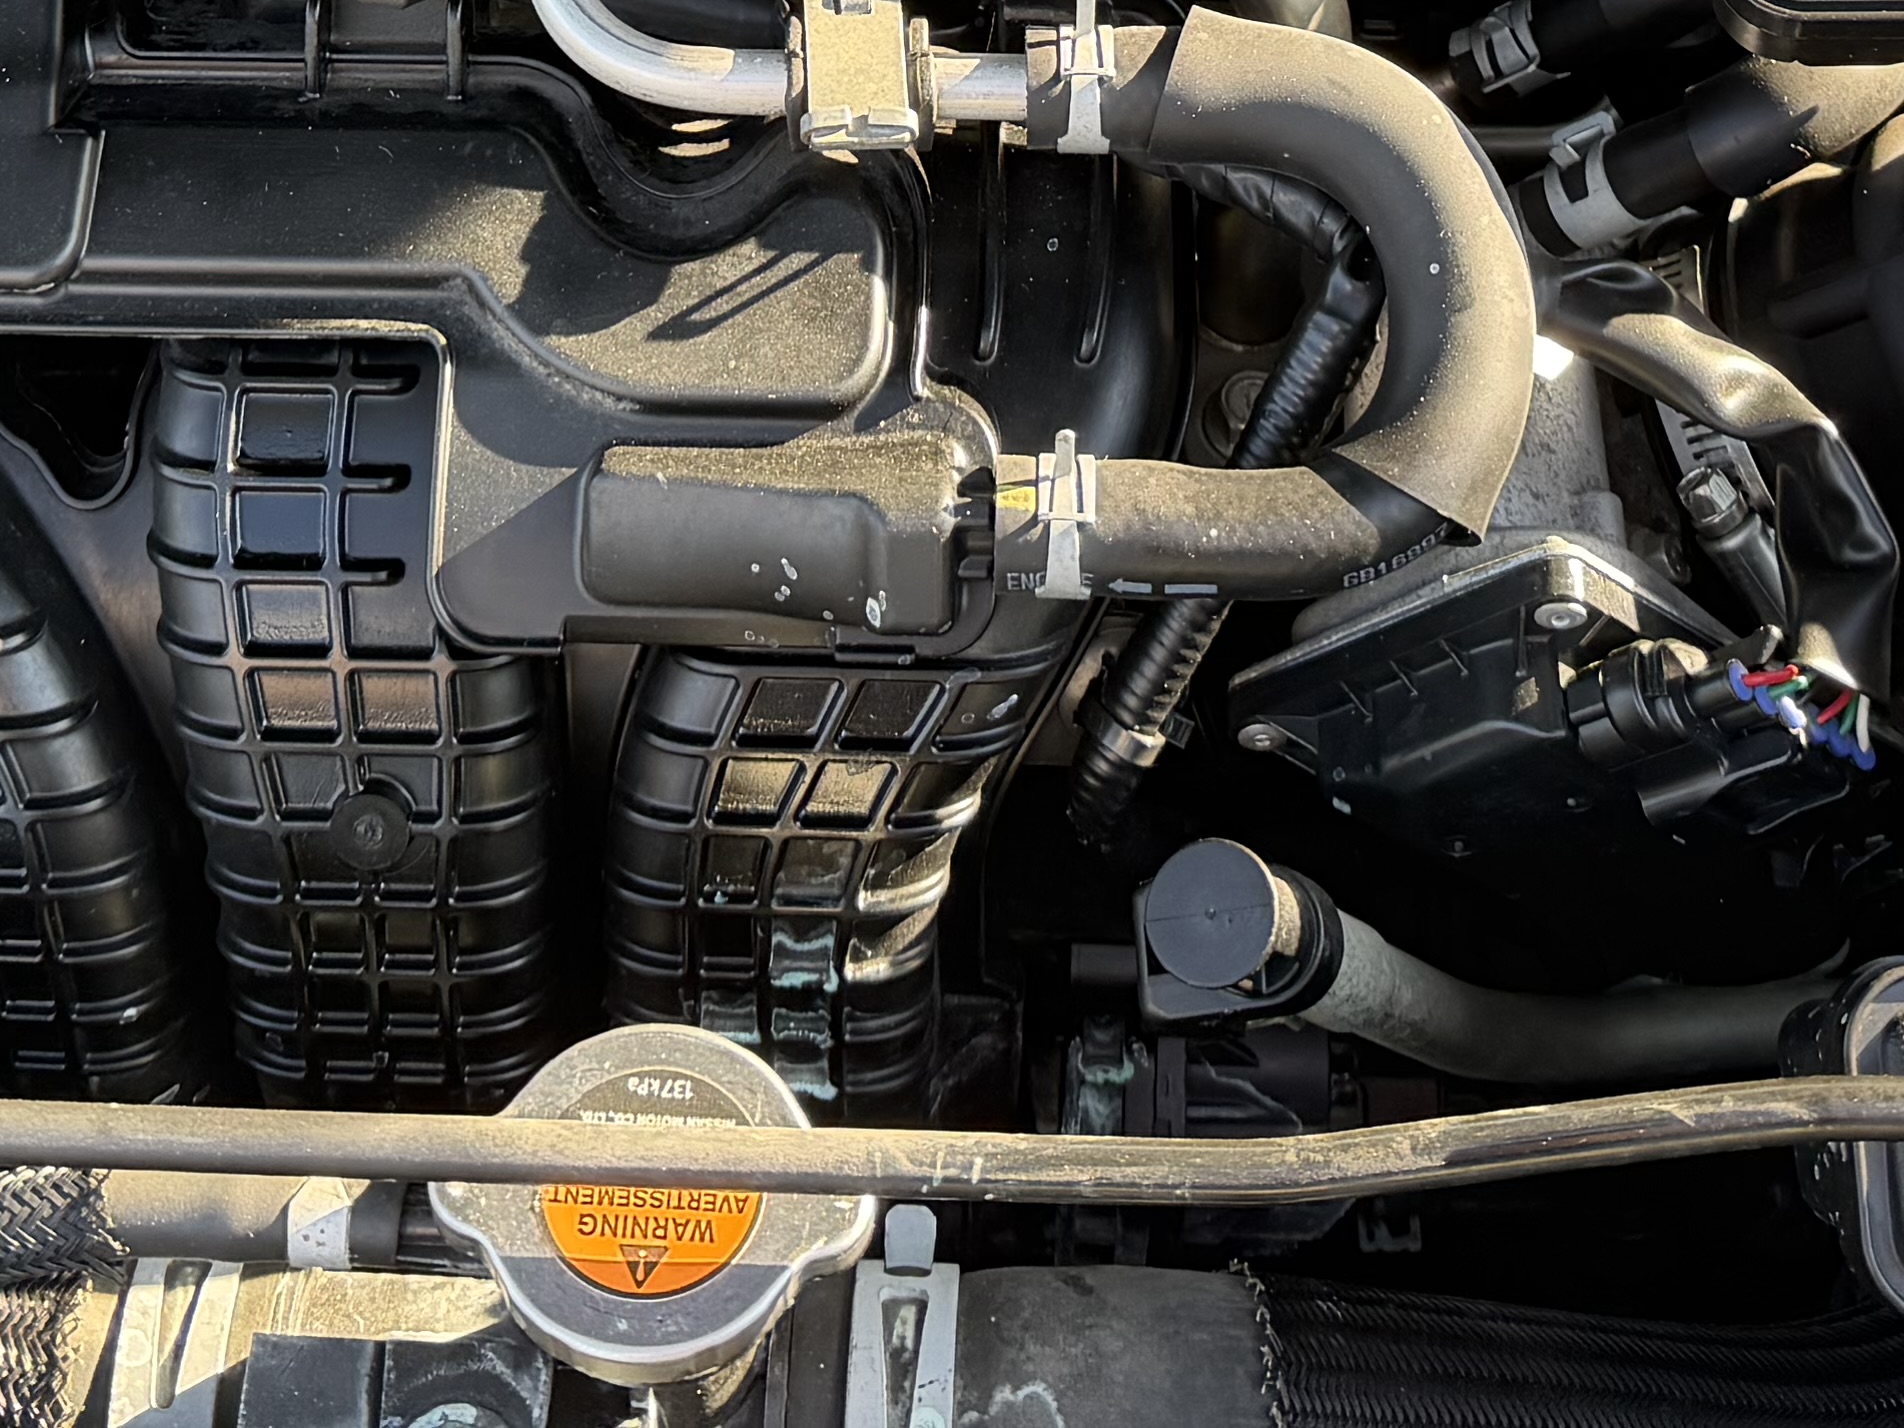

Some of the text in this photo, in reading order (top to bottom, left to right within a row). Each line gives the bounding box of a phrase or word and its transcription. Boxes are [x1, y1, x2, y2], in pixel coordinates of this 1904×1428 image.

[1007, 571, 1094, 590] ENE
[547, 1186, 750, 1214] AVERTISSEMENT
[578, 1213, 714, 1243] WARNING
